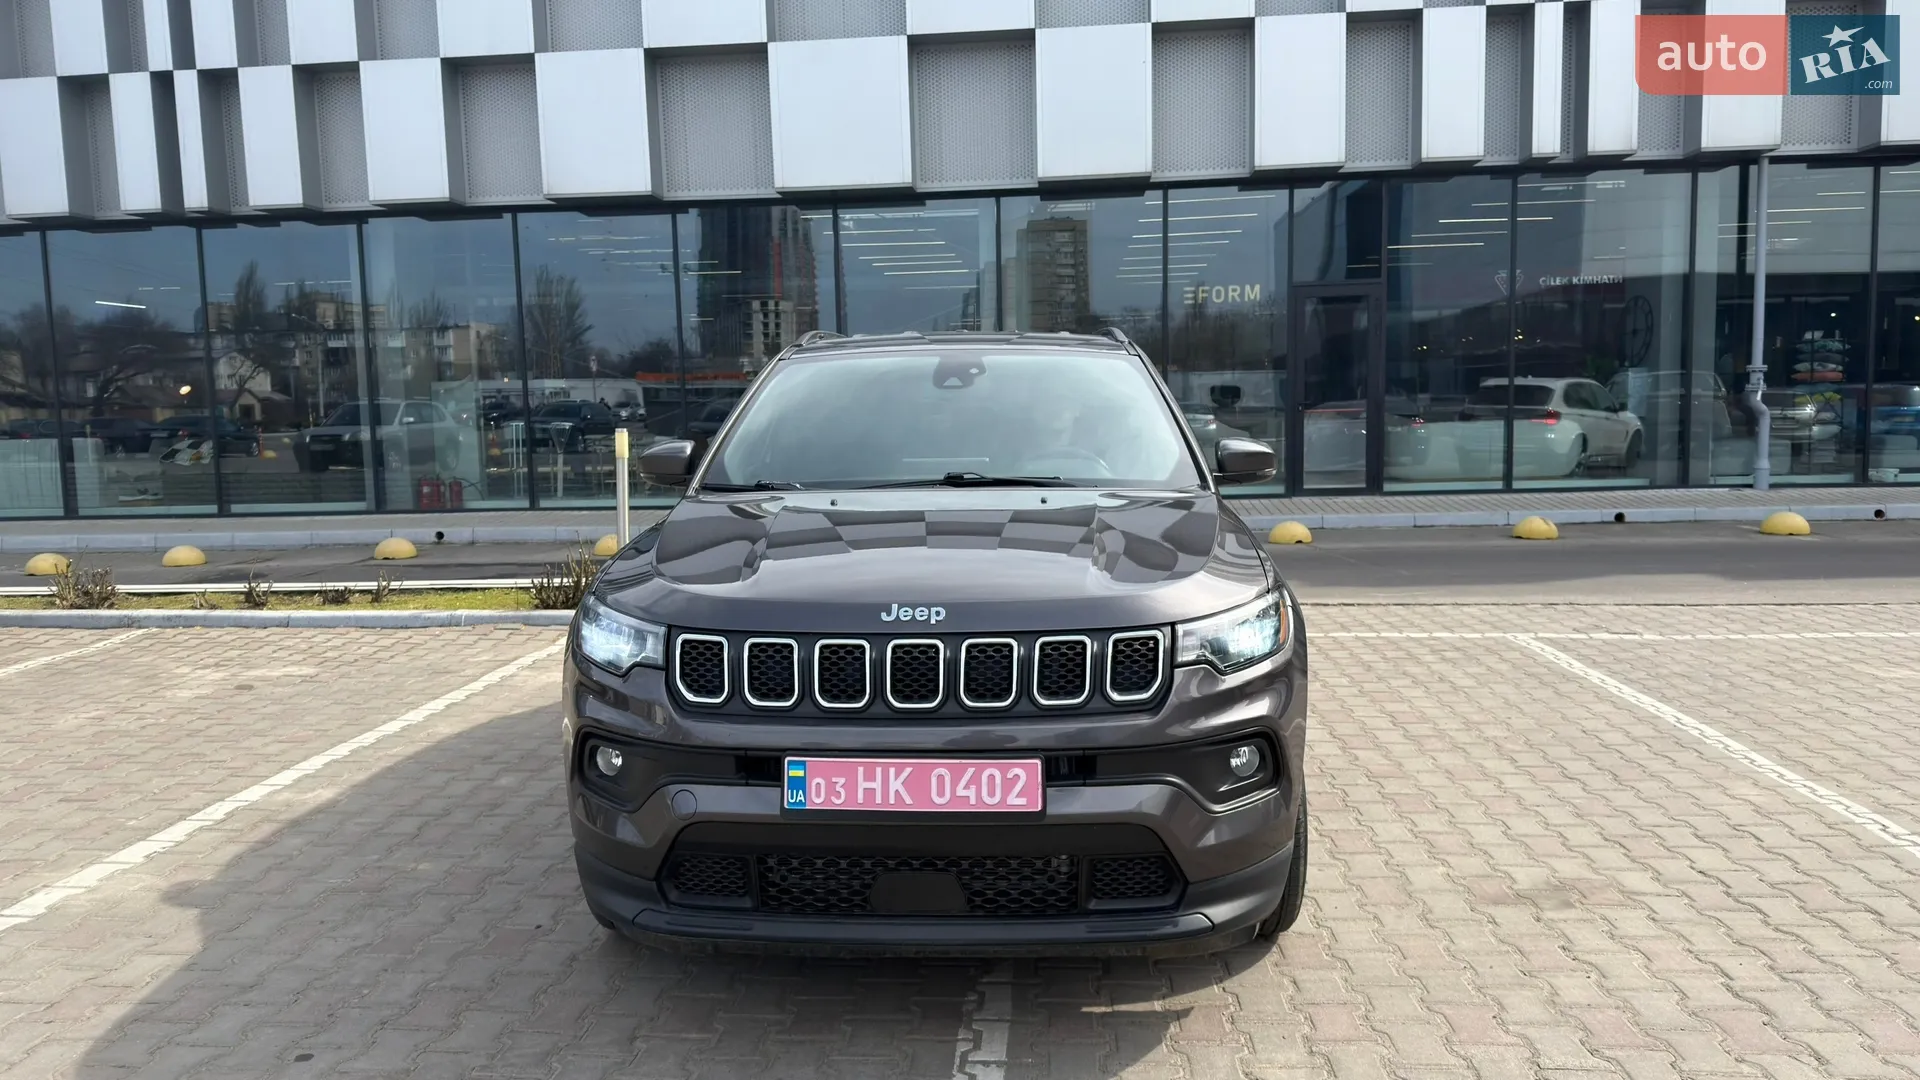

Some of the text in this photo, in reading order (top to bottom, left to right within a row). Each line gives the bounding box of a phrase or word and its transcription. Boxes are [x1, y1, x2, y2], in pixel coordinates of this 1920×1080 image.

[880, 603, 946, 625] Jeep
[788, 766, 1028, 806] UA 03 HK 0402
